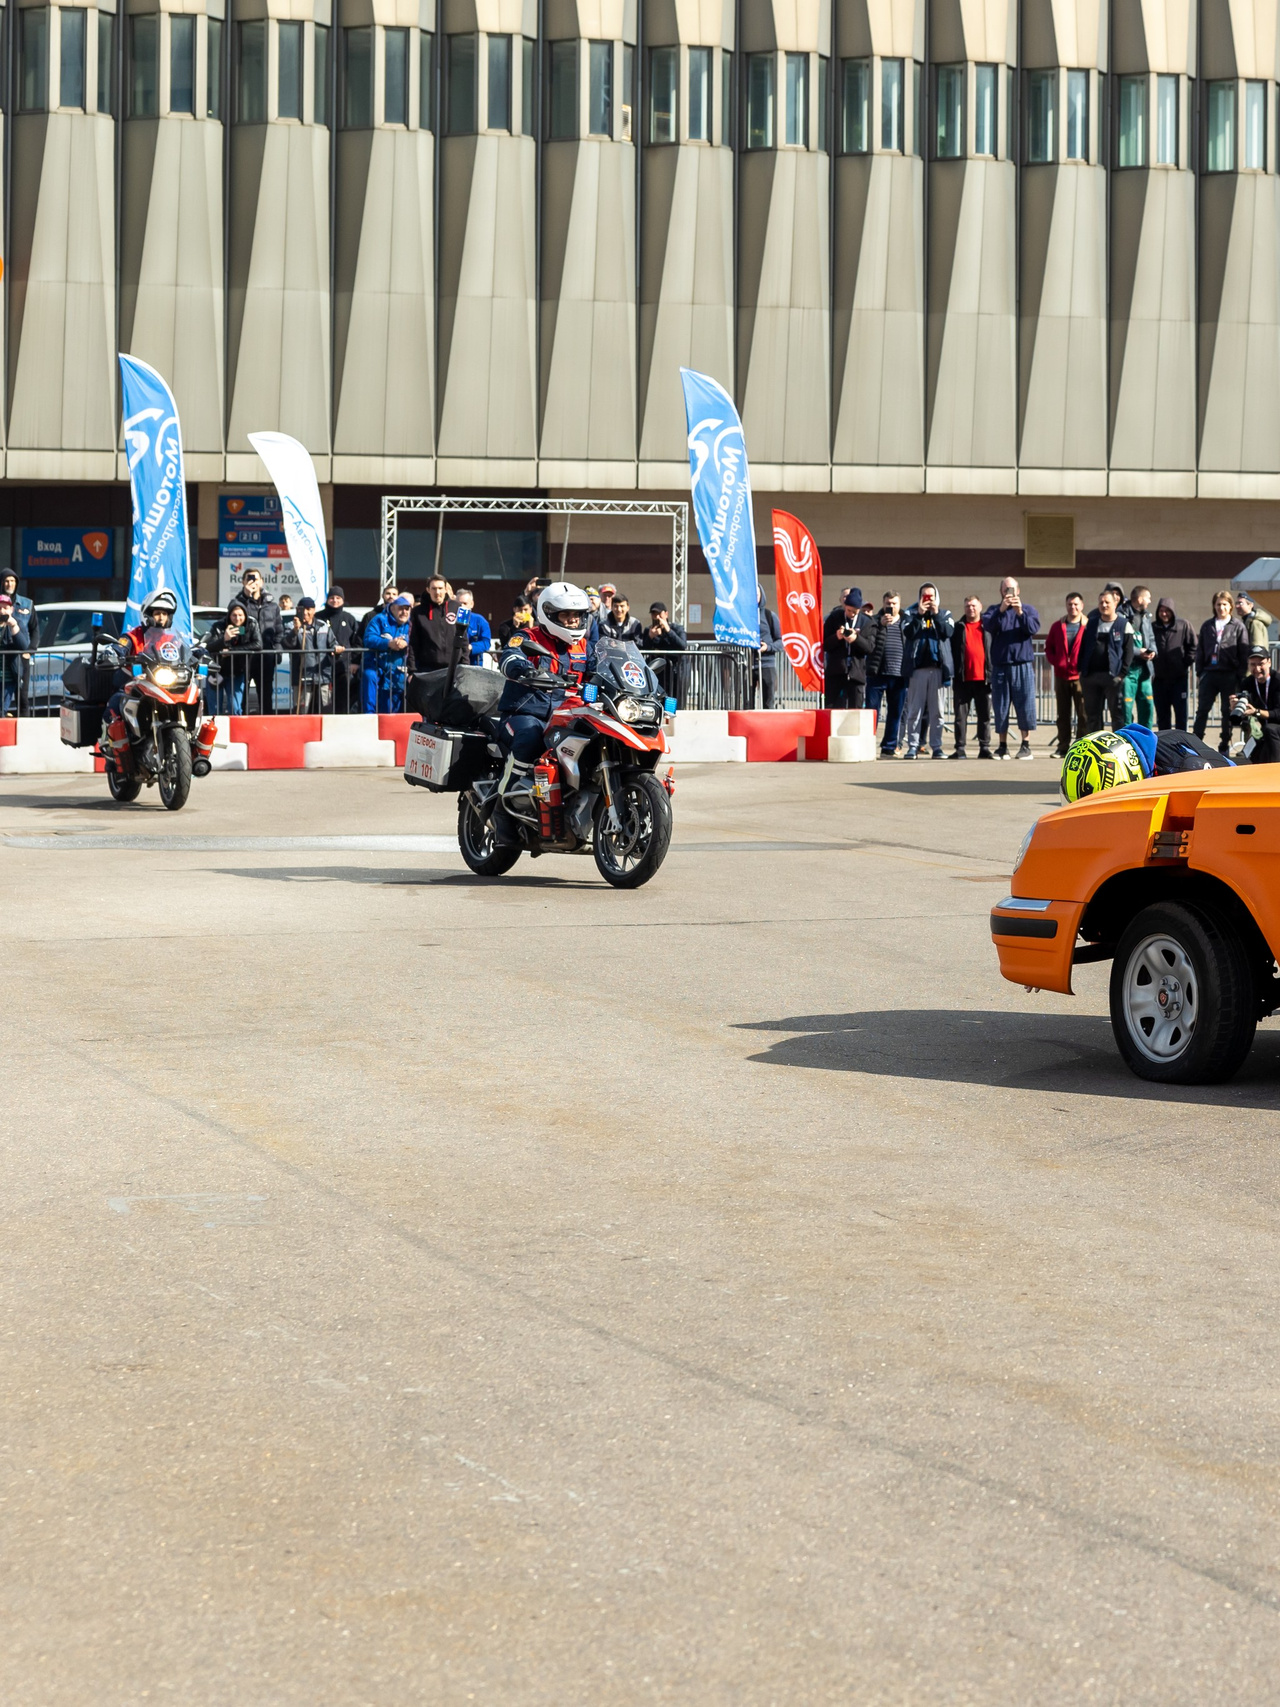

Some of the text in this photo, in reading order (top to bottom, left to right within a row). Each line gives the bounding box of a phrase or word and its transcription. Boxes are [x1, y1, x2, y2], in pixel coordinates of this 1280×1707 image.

[37, 540, 62, 553] Вход
[28, 555, 70, 567] Entrance
[561, 746, 575, 758] GS
[421, 762, 433, 780] 101
